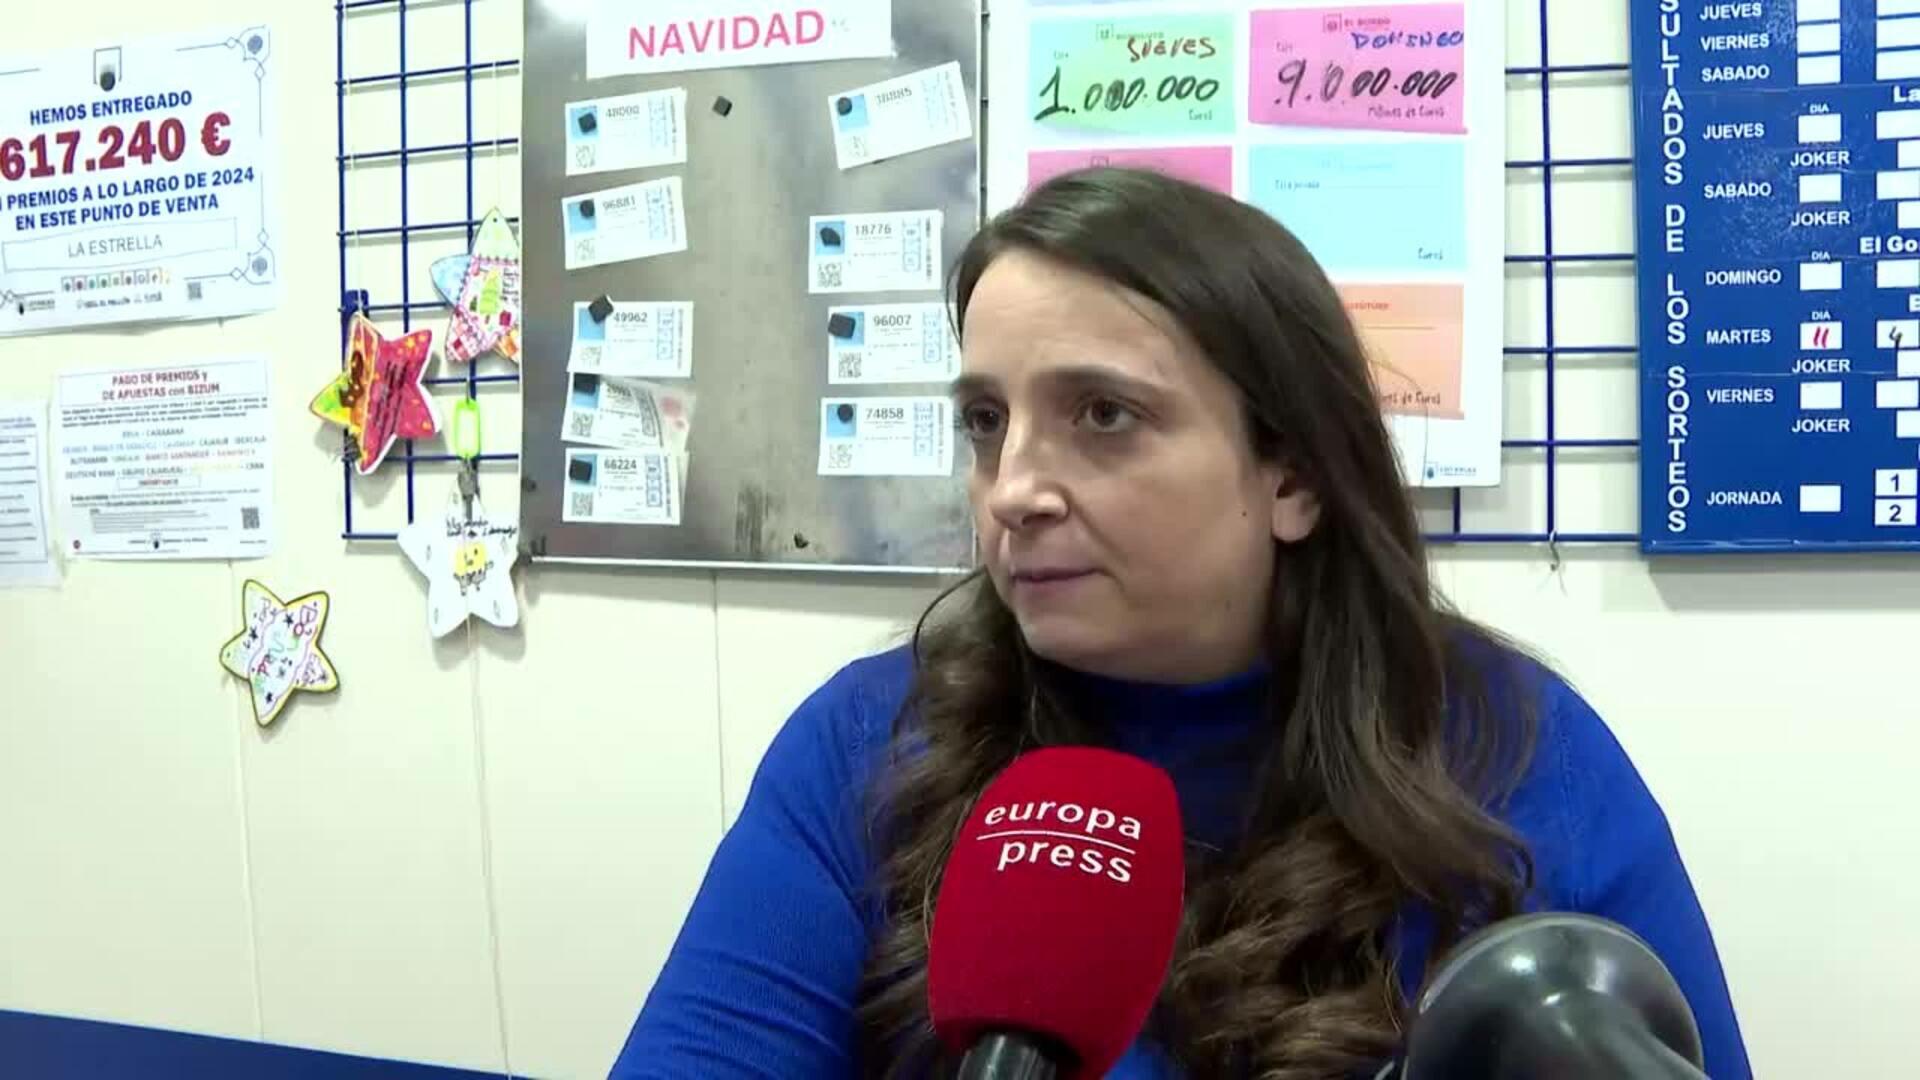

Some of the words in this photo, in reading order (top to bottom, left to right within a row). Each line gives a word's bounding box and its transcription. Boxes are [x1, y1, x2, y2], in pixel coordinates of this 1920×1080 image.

[1700, 3, 1762, 20] JUEVES
[628, 9, 825, 60] NAVIDAD
[1701, 33, 1769, 51] VIERNES
[1702, 65, 1770, 82] SABADO
[1035, 65, 1220, 121] 1.000.000
[30, 103, 87, 126] HEMOS
[92, 89, 193, 119] ENTREGADO
[1809, 103, 1829, 114] DIA
[1703, 123, 1765, 140] JUEVES
[0, 116, 186, 181] 617.240
[201, 111, 232, 157] €
[1790, 150, 1851, 168] JOKER
[7, 186, 79, 211] PREMIOS
[82, 185, 94, 202] A
[98, 181, 118, 200] LO
[122, 173, 180, 197] LARGO
[184, 171, 208, 190] DE
[212, 165, 256, 187] 2024
[1704, 183, 1772, 199] SABADO
[15, 214, 36, 231] EN
[40, 208, 77, 229] ESTE
[80, 201, 134, 223] PUNTO
[138, 199, 161, 218] DE
[164, 193, 220, 215] VENTA
[1791, 210, 1851, 227] JOKER
[855, 223, 892, 236] 18776
[1666, 205, 1687, 252] DE
[67, 241, 85, 259] LA
[89, 234, 163, 256] ESTRELLA
[1860, 235, 1881, 254] El
[1811, 250, 1831, 261] DIA
[1705, 269, 1782, 286] DOMINGO
[613, 311, 648, 323] 49962
[1666, 274, 1690, 345] LOS
[1811, 310, 1831, 321] DIA
[873, 314, 912, 327] 96007
[1706, 329, 1771, 345] MARTES
[1791, 359, 1851, 374] JOKER
[141, 373, 153, 384] DE
[156, 369, 200, 383] PREMIOS
[118, 386, 166, 400] APUESTAS
[187, 383, 220, 395] BIZUM
[1707, 388, 1774, 404] VIERNES
[866, 407, 904, 420] 74858
[1791, 418, 1851, 433] JOKER
[1667, 365, 1691, 533] SORTEOS
[604, 458, 637, 471] 66224
[1890, 472, 1900, 493] 1
[1706, 491, 1783, 506] JORNADA
[1888, 503, 1902, 523] 2
[985, 801, 1142, 840] europa
[997, 841, 1132, 883] press
